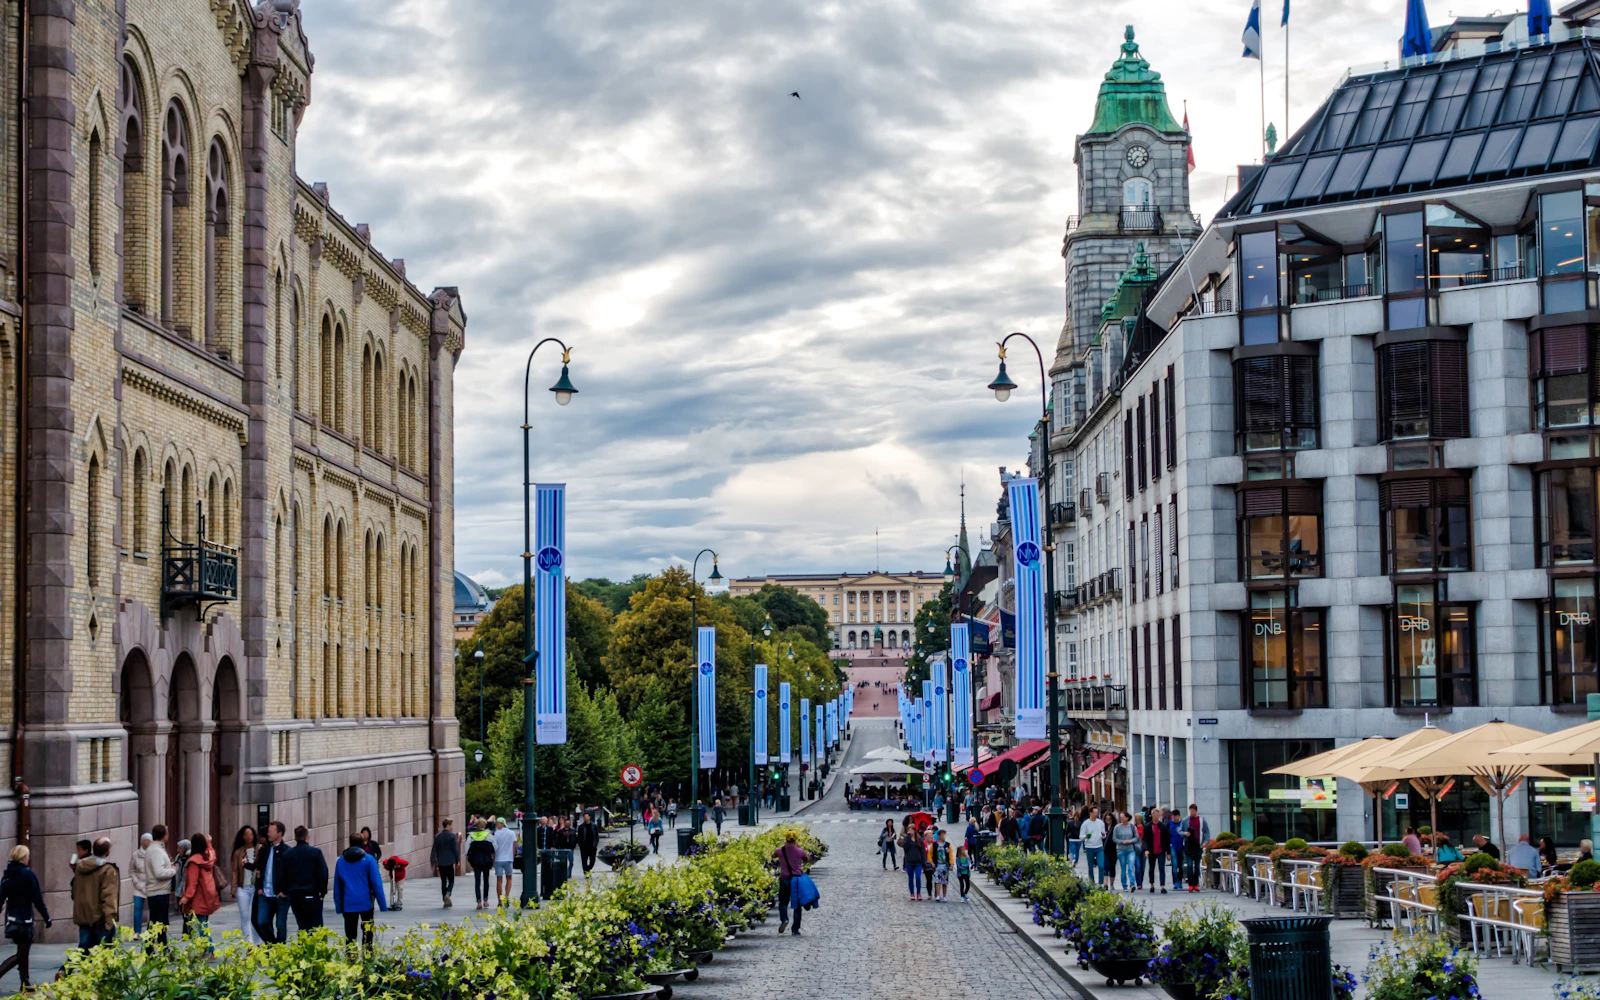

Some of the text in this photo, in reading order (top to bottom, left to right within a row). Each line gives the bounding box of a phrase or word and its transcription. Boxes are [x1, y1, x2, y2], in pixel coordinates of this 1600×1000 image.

[540, 547, 560, 568] NJM
[1019, 542, 1038, 563] NJM
[1402, 618, 1430, 631] DNB
[1560, 612, 1590, 625] DNB
[1057, 623, 1073, 634] OTEL
[1255, 623, 1281, 635] DNB
